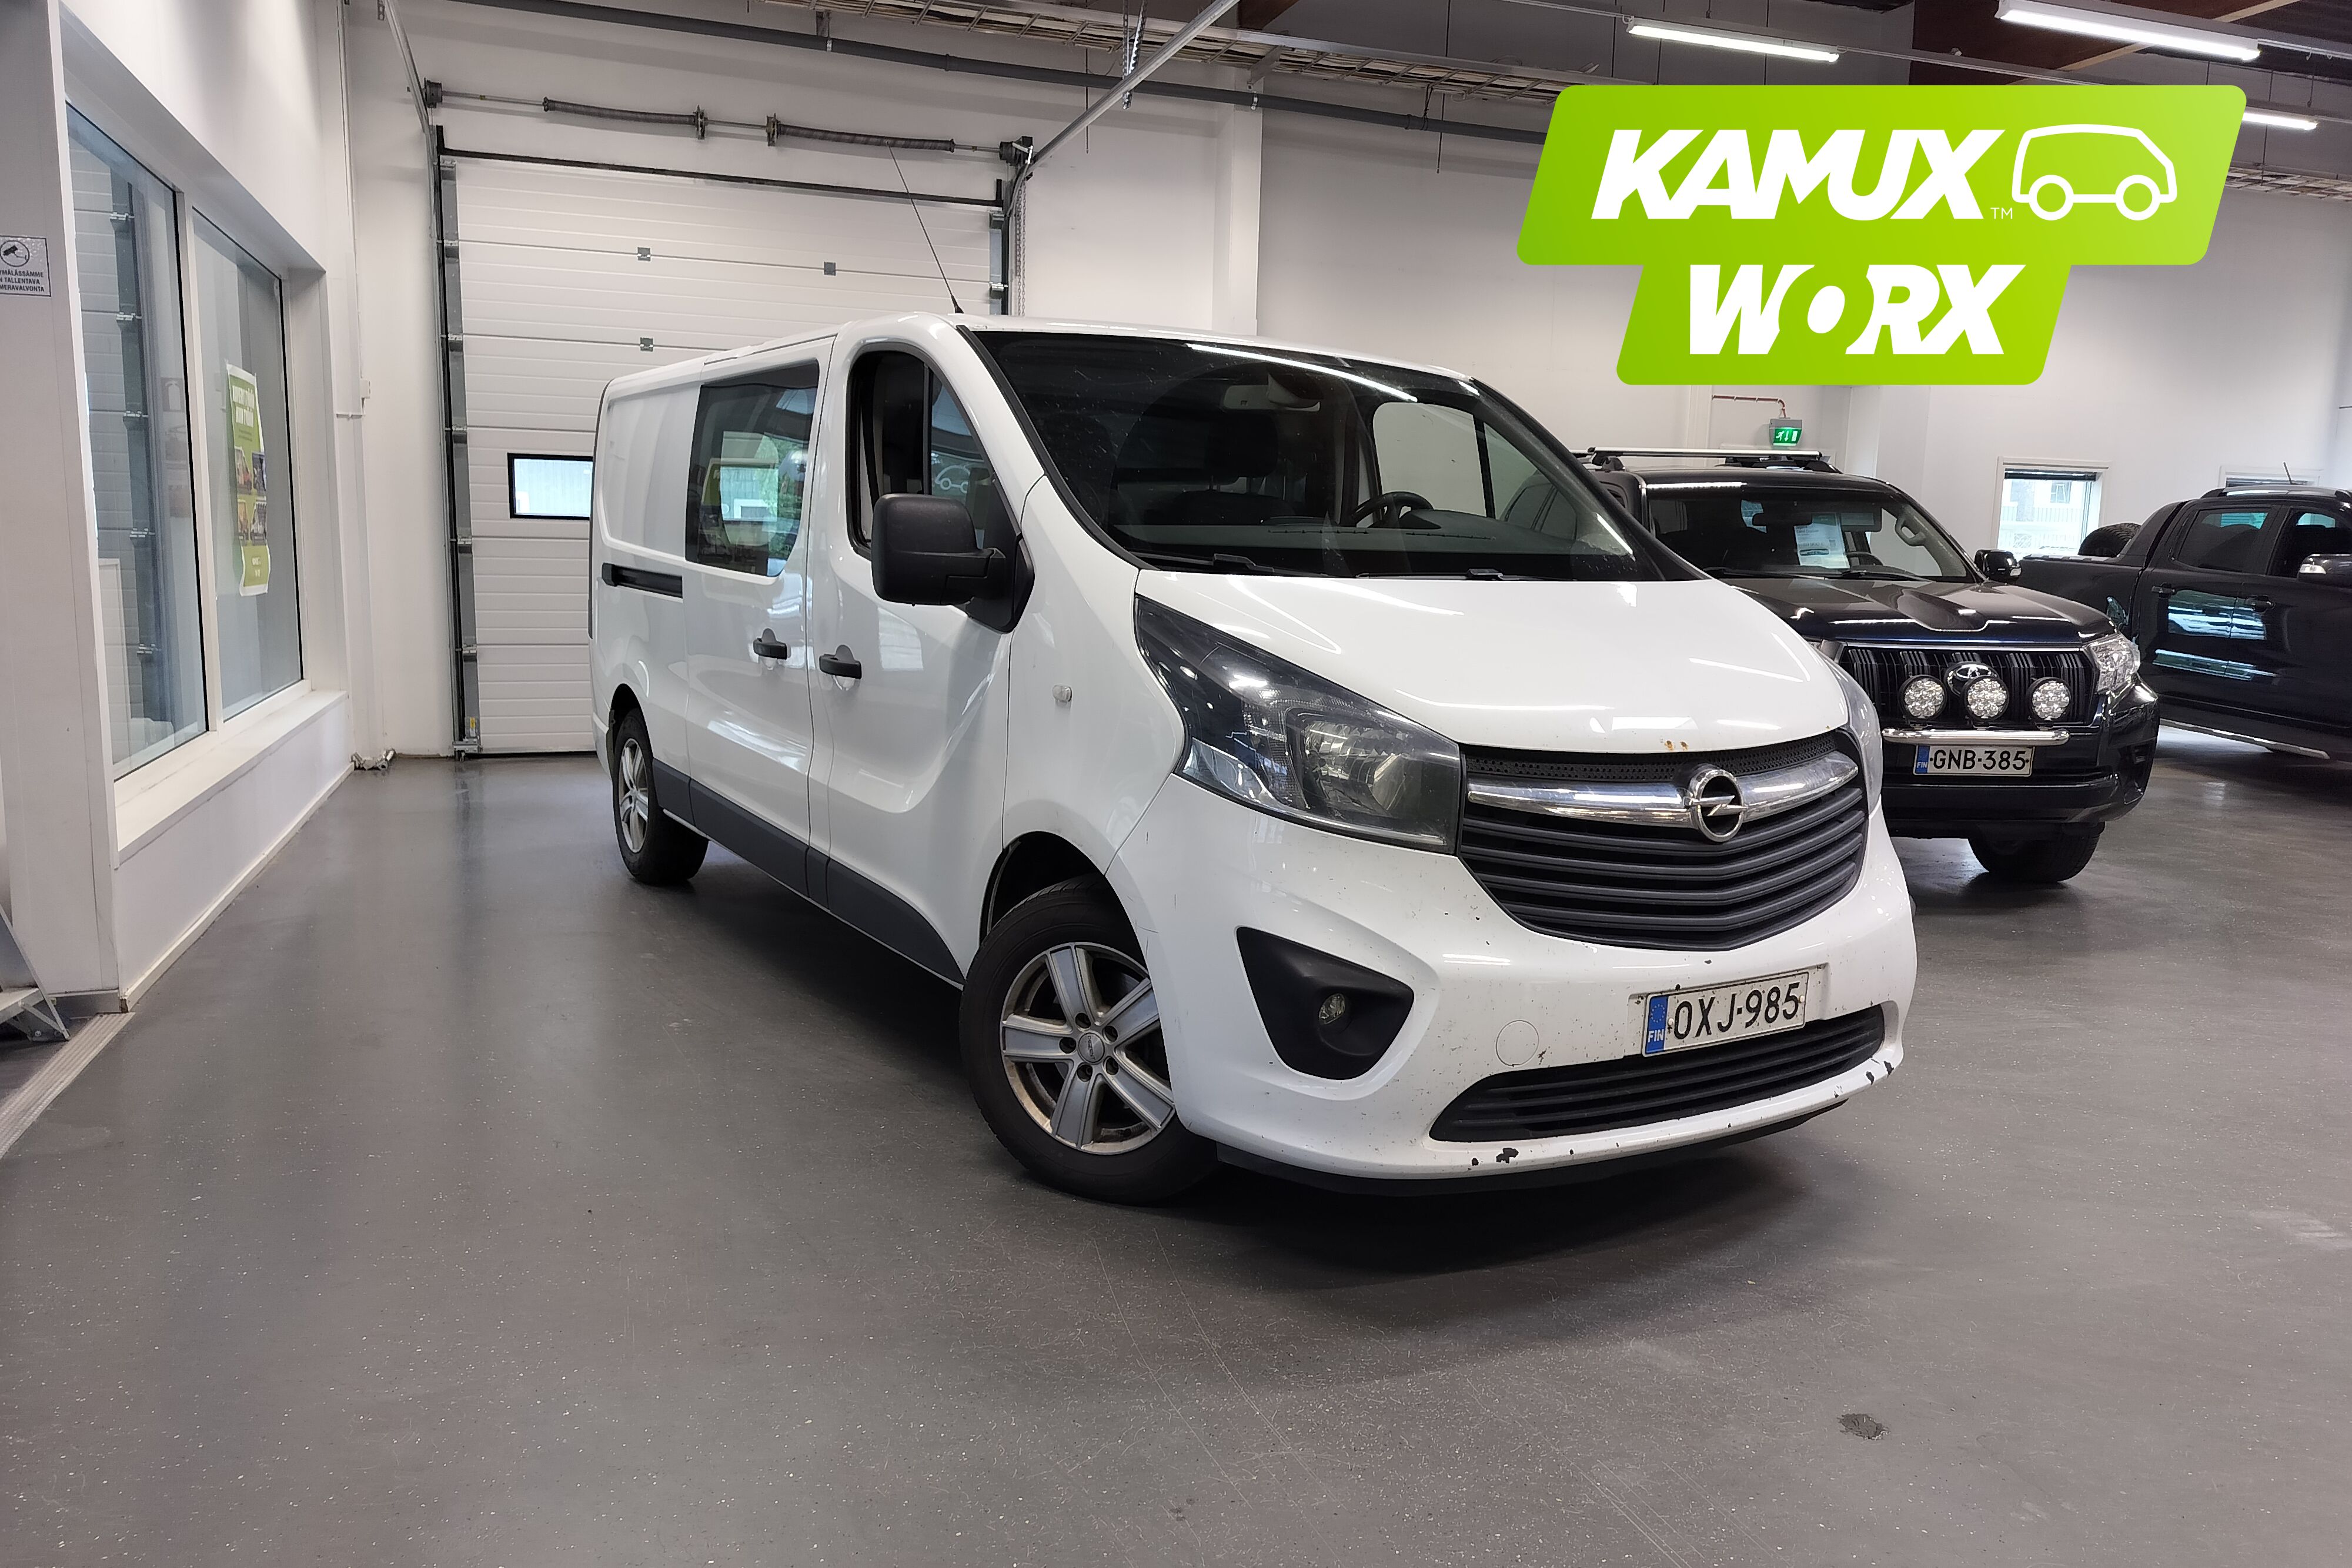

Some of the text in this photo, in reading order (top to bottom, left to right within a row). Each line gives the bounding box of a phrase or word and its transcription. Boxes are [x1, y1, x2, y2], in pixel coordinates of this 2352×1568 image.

[1933, 749, 2026, 770] GNB-385
[1673, 982, 1800, 1039] OXJ-985
[1648, 1029, 1664, 1043] FIN
